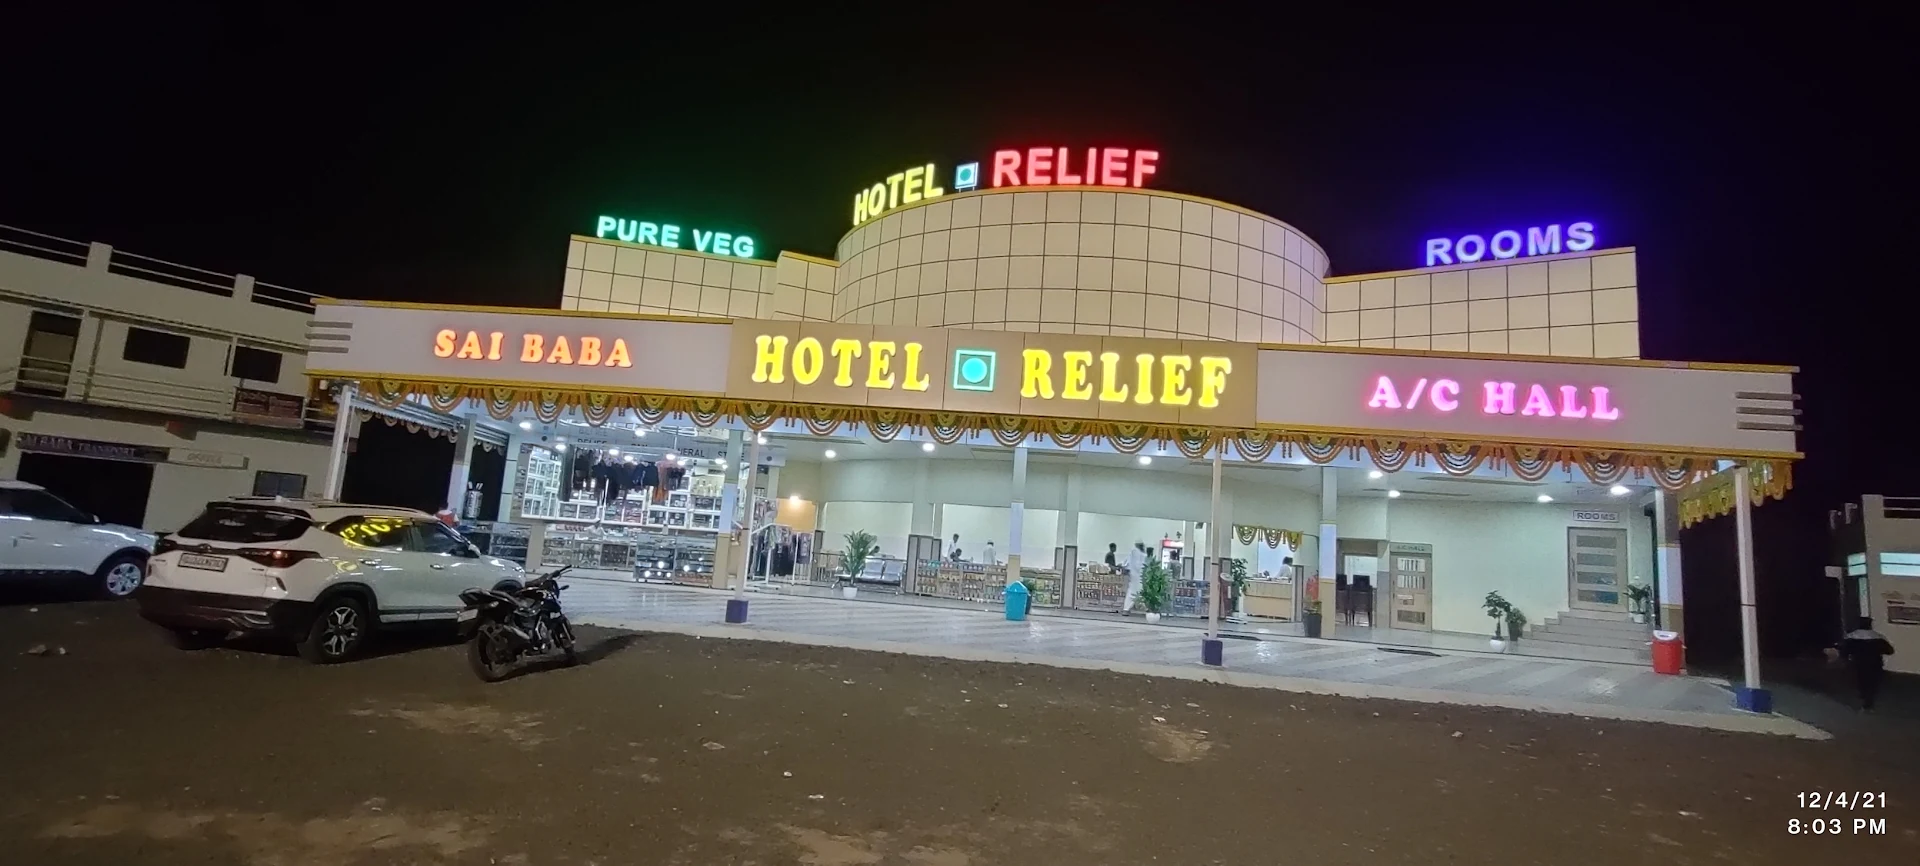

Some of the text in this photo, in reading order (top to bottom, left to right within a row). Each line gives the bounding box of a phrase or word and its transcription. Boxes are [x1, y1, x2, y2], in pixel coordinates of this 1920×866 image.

[852, 147, 1159, 226] HOTEL RELIEF
[596, 215, 754, 258] PURE VEG
[1426, 222, 1595, 266] ROOMS
[434, 329, 633, 368] SAI BABA
[751, 335, 1233, 408] HOTEL RELIEF
[1368, 376, 1619, 420] A/C HALL
[1576, 512, 1616, 521] ROOMS
